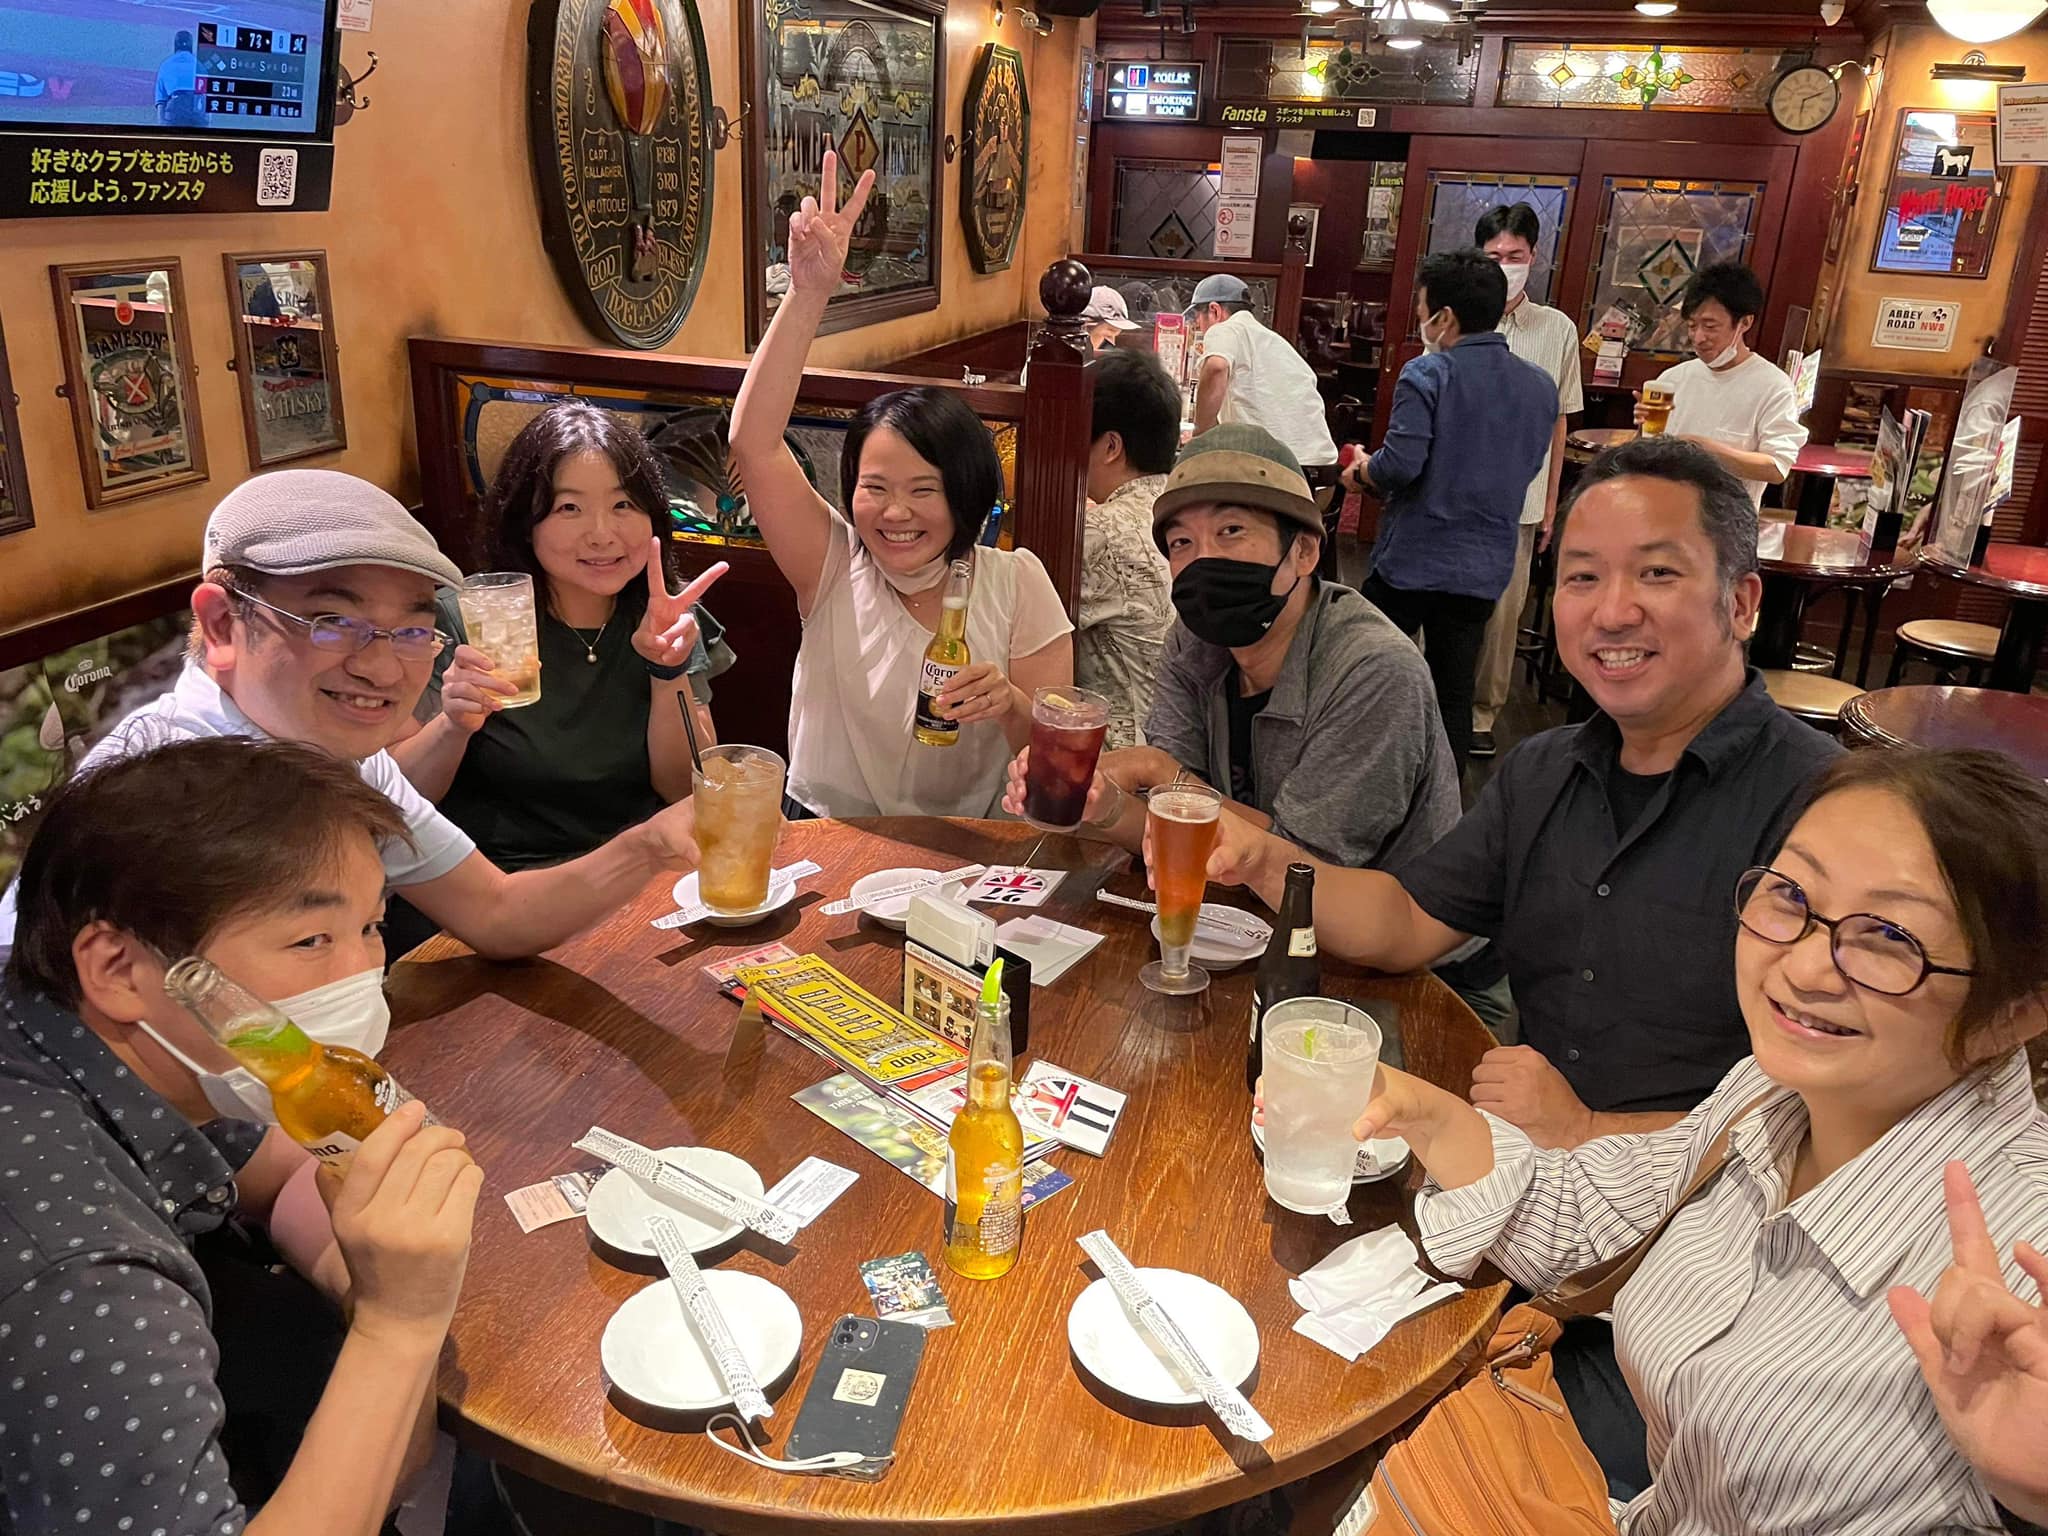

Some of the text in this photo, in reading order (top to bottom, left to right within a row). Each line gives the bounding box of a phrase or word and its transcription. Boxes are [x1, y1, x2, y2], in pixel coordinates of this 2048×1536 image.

[1153, 72, 1191, 84] TOILET
[682, 55, 700, 149] GRAND
[1148, 95, 1193, 106] SMOKING
[1155, 104, 1185, 115] ROOM
[1221, 105, 1267, 122] Fansta
[31, 148, 233, 175] 好きなクラブをお店からも
[656, 146, 676, 164] FEB
[584, 166, 624, 178] GALLAGHER
[29, 178, 206, 205] 応援しよう。ファンスタ
[656, 199, 678, 217] 1879
[681, 156, 701, 249] CANYON
[590, 246, 686, 286] GOD BLESS
[608, 284, 673, 327] IRELAND
[1888, 309, 1923, 320] ABBEY
[1886, 319, 1946, 332] ROAD NW8
[93, 329, 163, 360] JAMESON
[64, 664, 113, 693] Corona
[889, 1049, 938, 1069] FOOD
